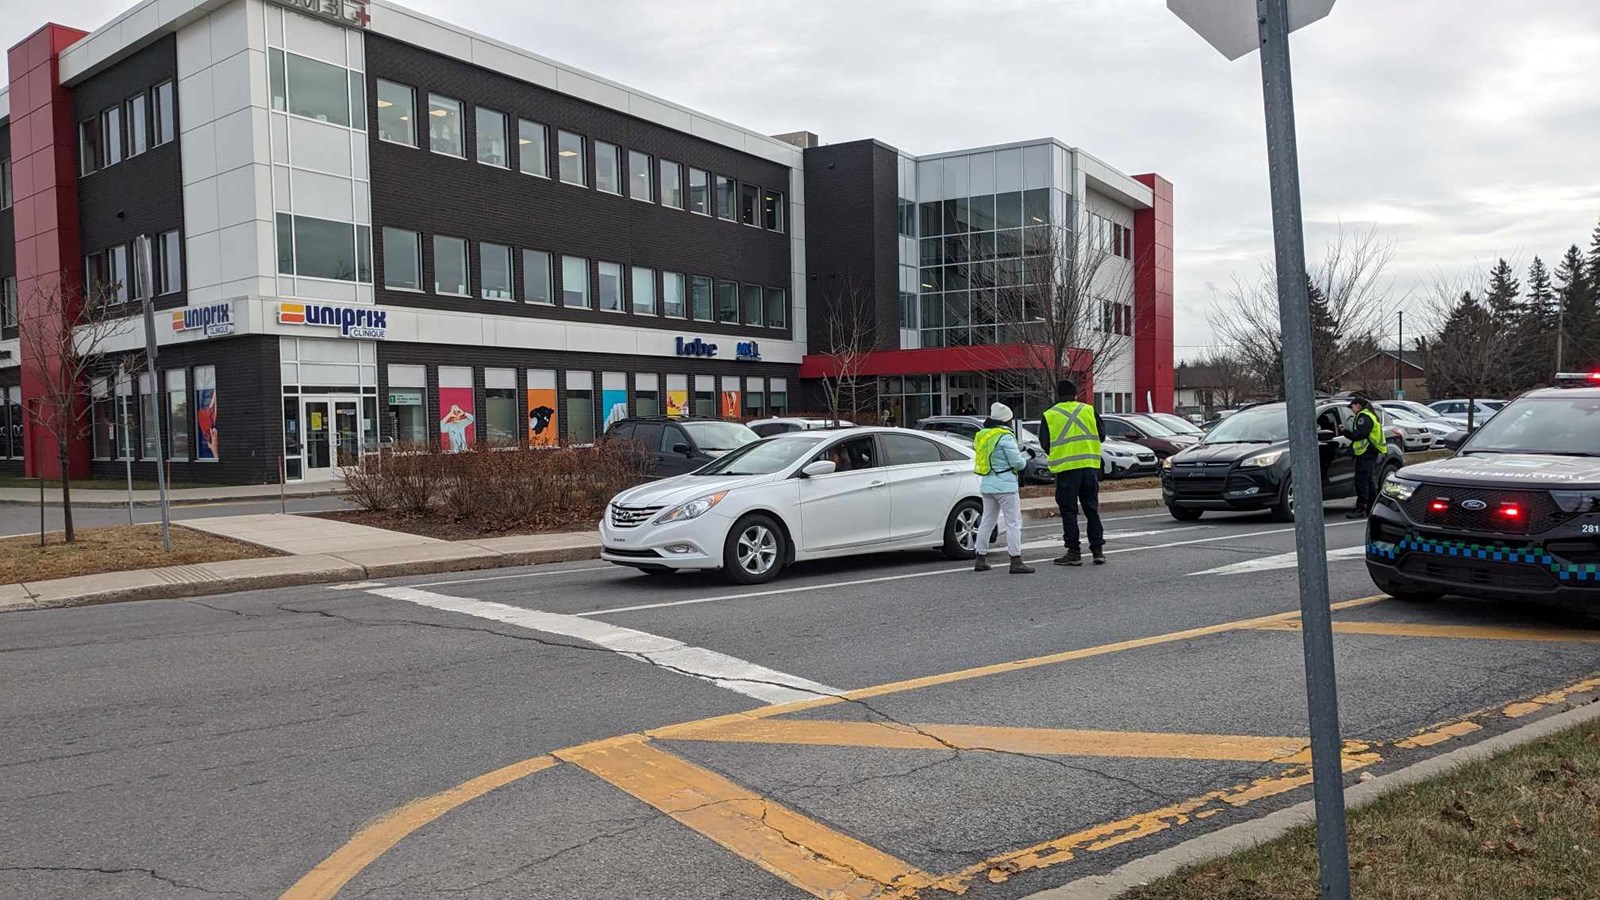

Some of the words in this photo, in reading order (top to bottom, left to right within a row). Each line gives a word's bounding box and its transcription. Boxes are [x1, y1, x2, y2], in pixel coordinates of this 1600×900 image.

[184, 303, 229, 336] uniprix
[305, 305, 386, 335] uniprix
[353, 329, 386, 338] CLINIQUE
[1582, 524, 1599, 533] 281
